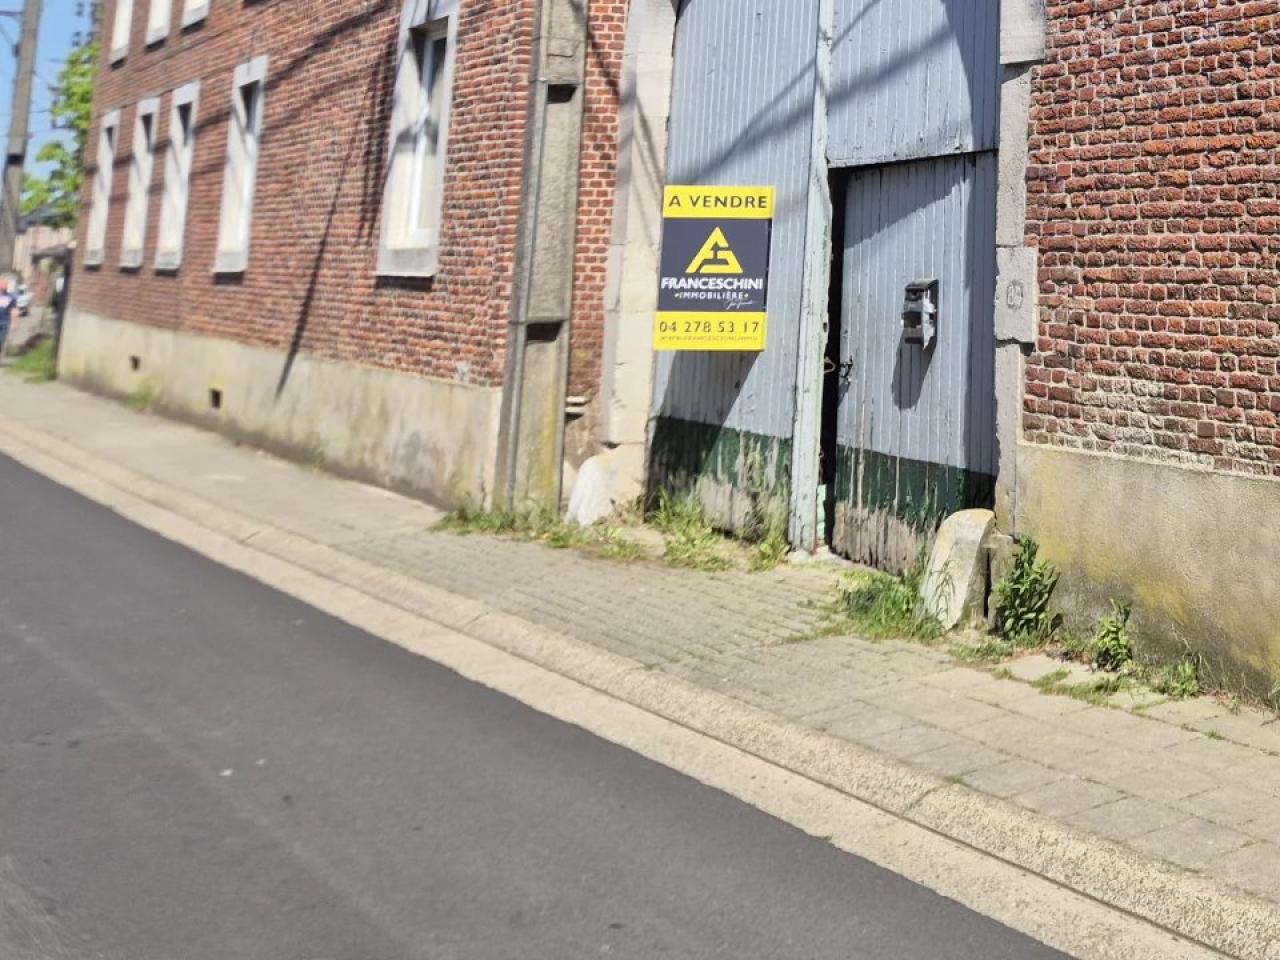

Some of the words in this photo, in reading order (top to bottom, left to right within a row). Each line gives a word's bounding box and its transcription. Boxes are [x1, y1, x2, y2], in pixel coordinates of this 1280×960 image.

[668, 195, 681, 208] A
[689, 195, 768, 209] VENDRE
[661, 276, 764, 290] FRANCESCHINI
[659, 320, 678, 333] 04
[683, 320, 712, 333] 278
[718, 320, 735, 333] 53
[743, 320, 760, 333] 17
